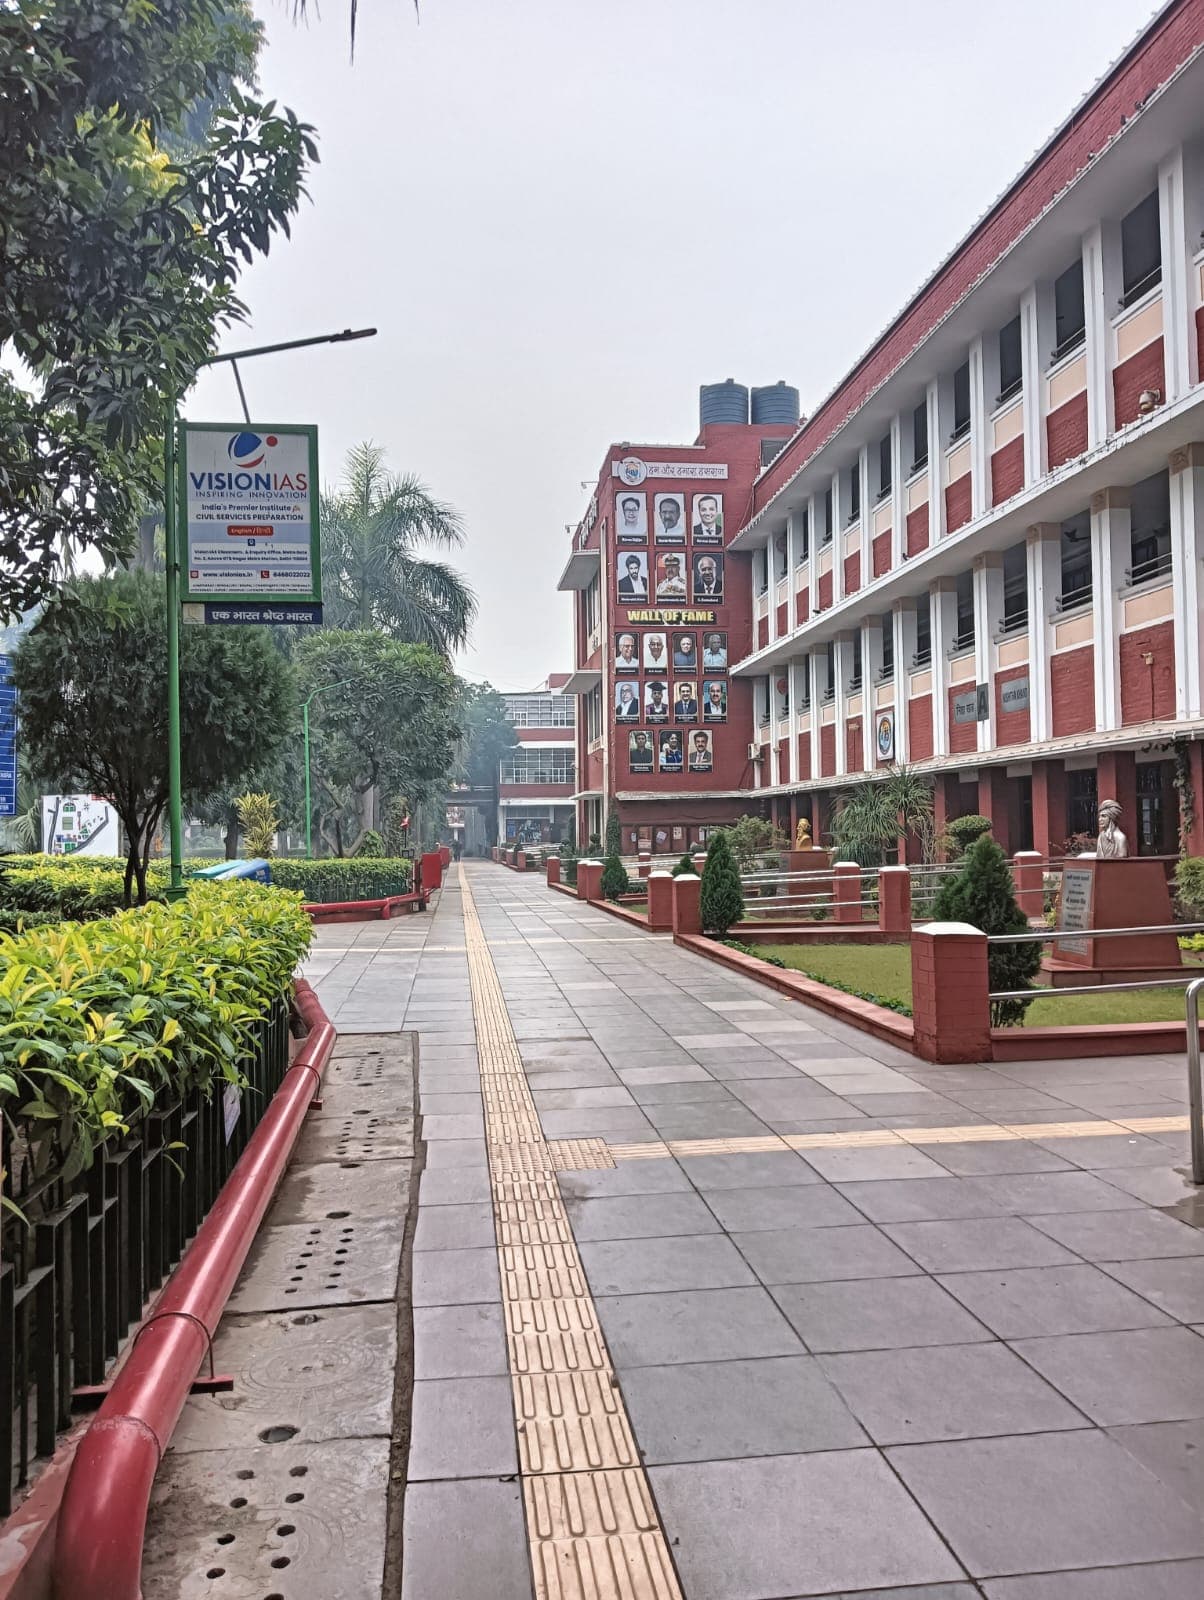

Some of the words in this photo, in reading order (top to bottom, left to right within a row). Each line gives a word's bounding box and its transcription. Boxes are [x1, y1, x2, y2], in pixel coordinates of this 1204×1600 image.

[249, 491, 307, 499] INNOVATION
[201, 503, 227, 511] India's
[211, 610, 231, 620] एक
[233, 610, 260, 620] भारत
[286, 611, 313, 621] भारत
[627, 610, 661, 622] WALL
[663, 610, 680, 622] OF
[681, 610, 715, 622] FAME
